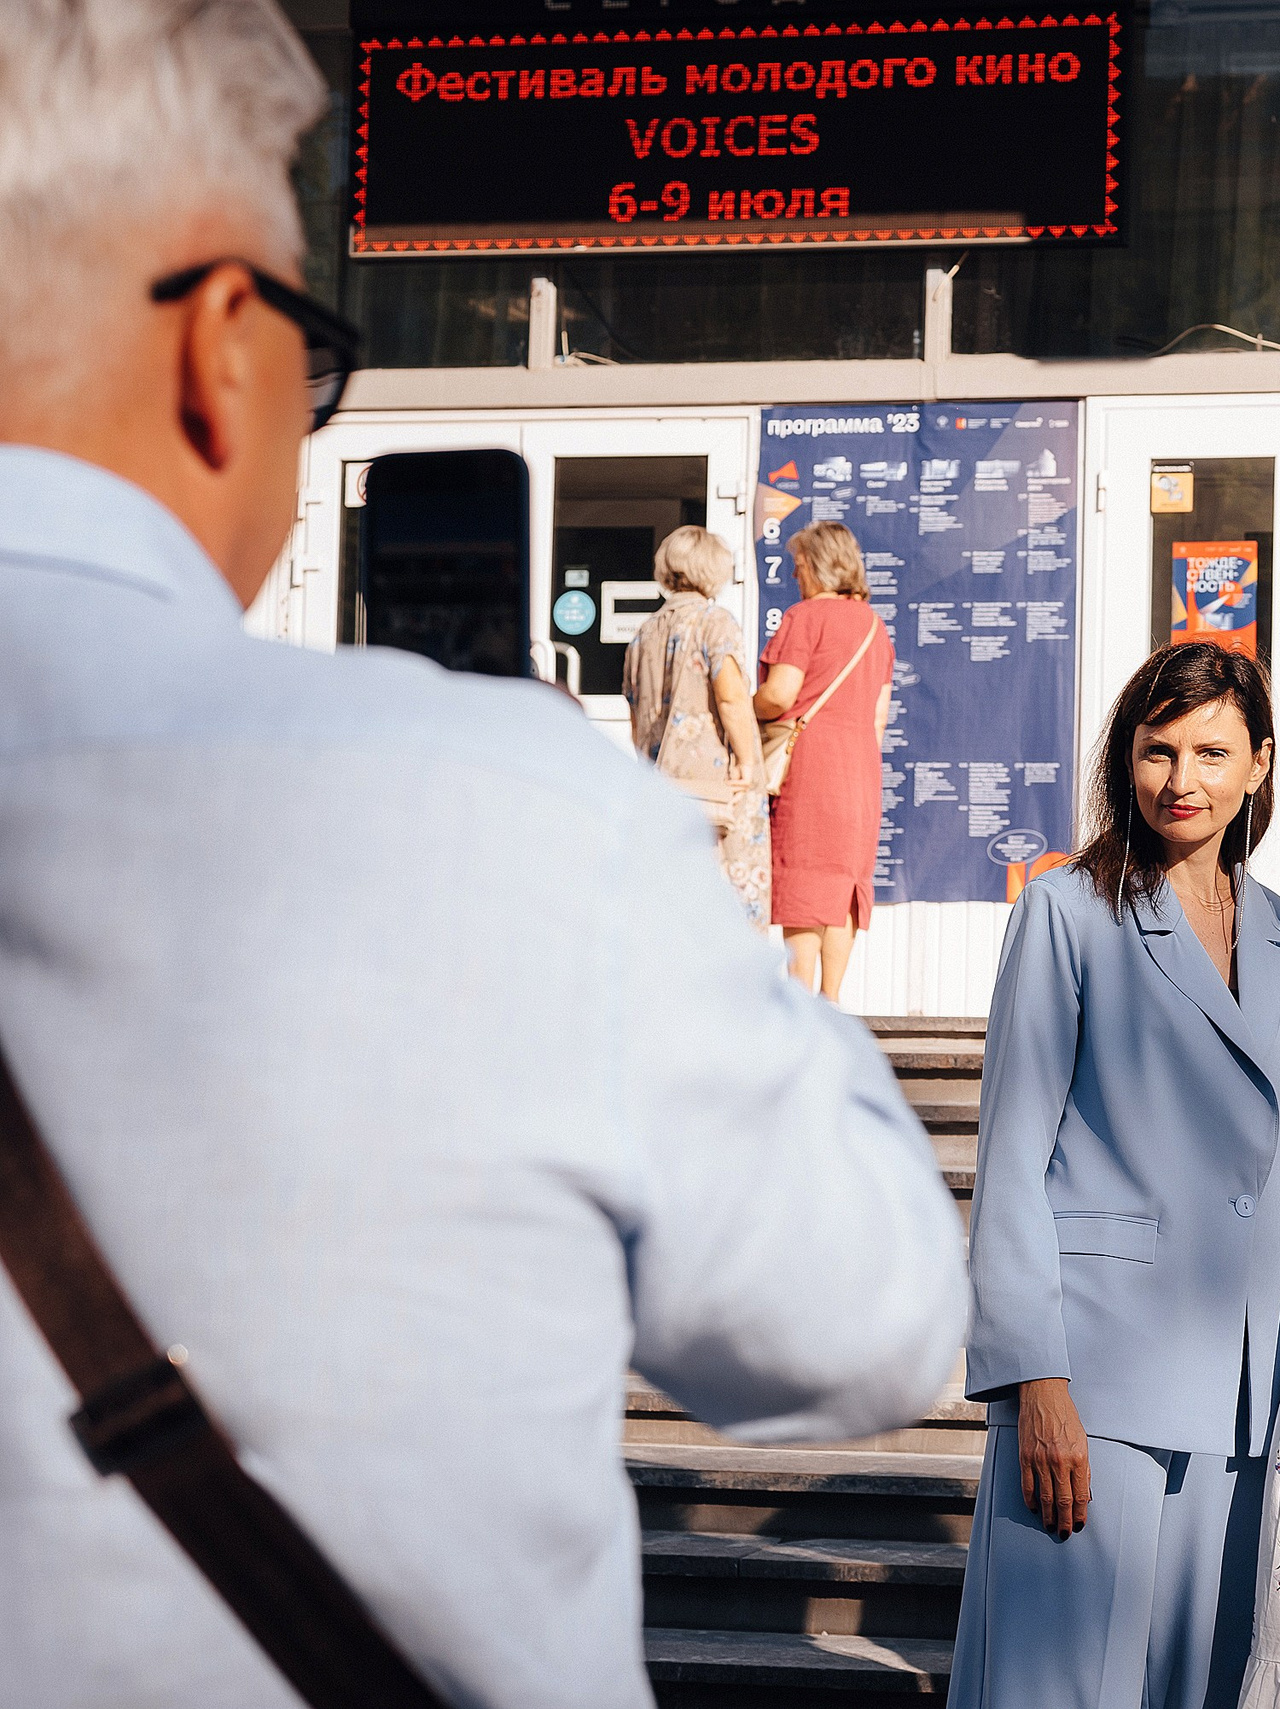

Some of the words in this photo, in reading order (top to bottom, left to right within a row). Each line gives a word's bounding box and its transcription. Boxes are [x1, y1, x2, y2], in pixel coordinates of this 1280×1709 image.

[396, 62, 667, 102] Фестиваль
[684, 57, 937, 99] молодого
[954, 52, 1081, 86] кино
[625, 113, 820, 159] VOICES
[608, 180, 691, 223] 6-9
[707, 186, 850, 220] июля
[767, 417, 884, 438] программа
[763, 517, 781, 539] 6
[764, 556, 783, 578] 7
[765, 608, 783, 631] 8
